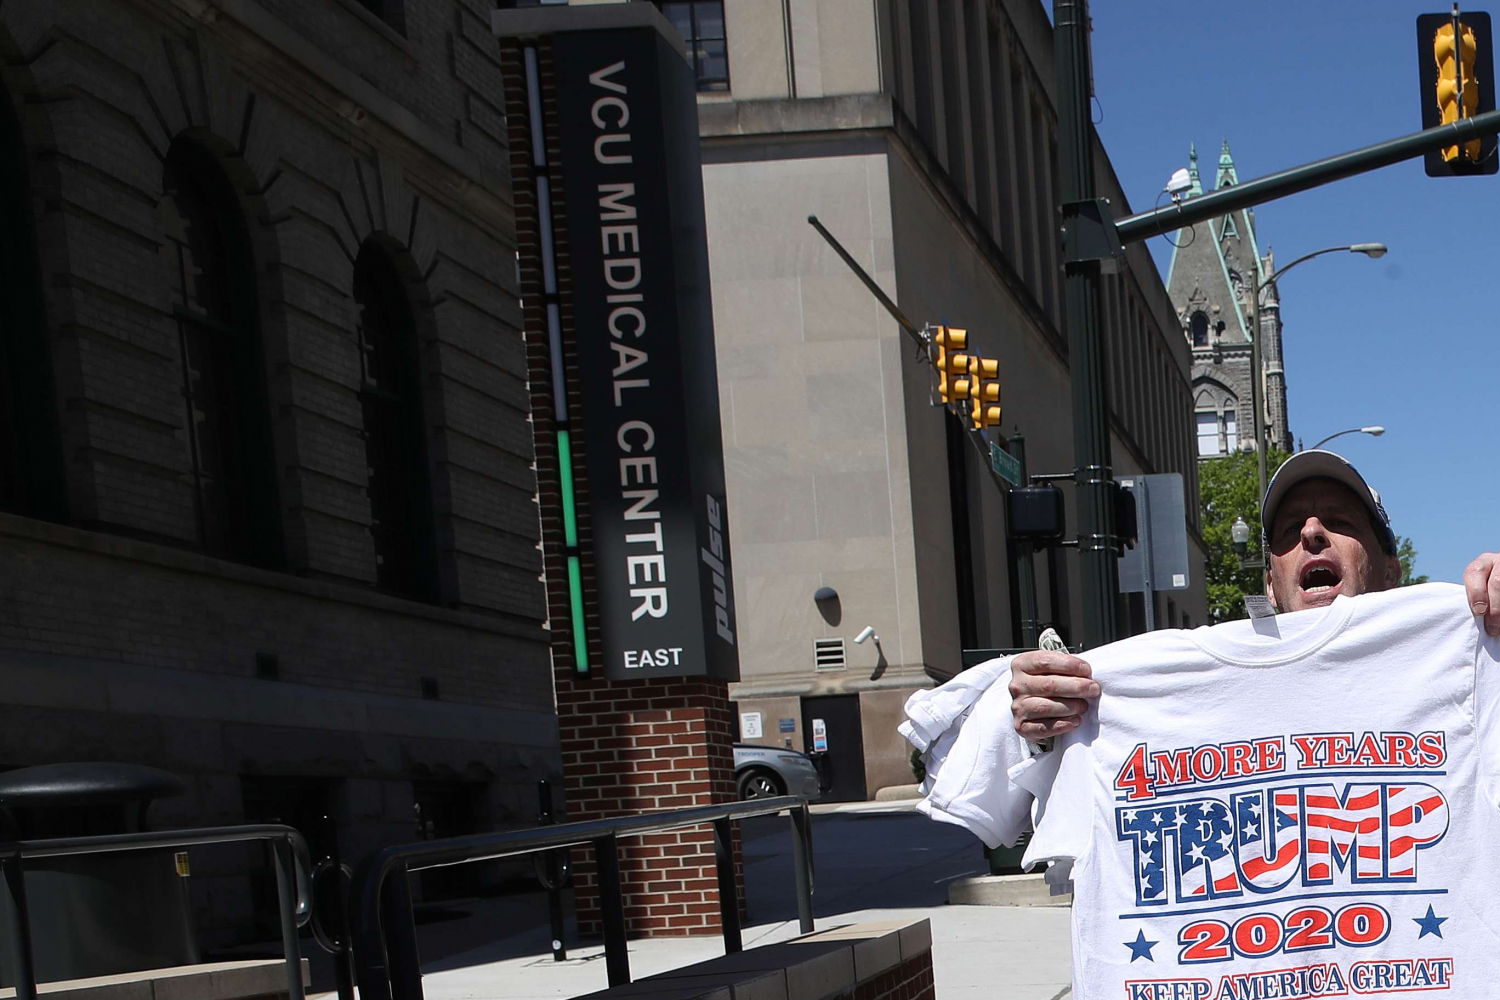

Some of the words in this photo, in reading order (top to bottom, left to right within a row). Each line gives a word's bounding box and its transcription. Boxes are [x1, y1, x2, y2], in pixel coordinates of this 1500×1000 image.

[588, 60, 633, 165] VCU
[597, 182, 650, 407] MEDICAL
[616, 420, 669, 622] CENTER
[701, 494, 734, 645] pulse
[623, 648, 683, 668] EAST
[1291, 731, 1447, 770] YEARS
[1115, 782, 1450, 906] TRUMP
[1178, 903, 1391, 964] 2020
[1350, 958, 1454, 993] GREAT
